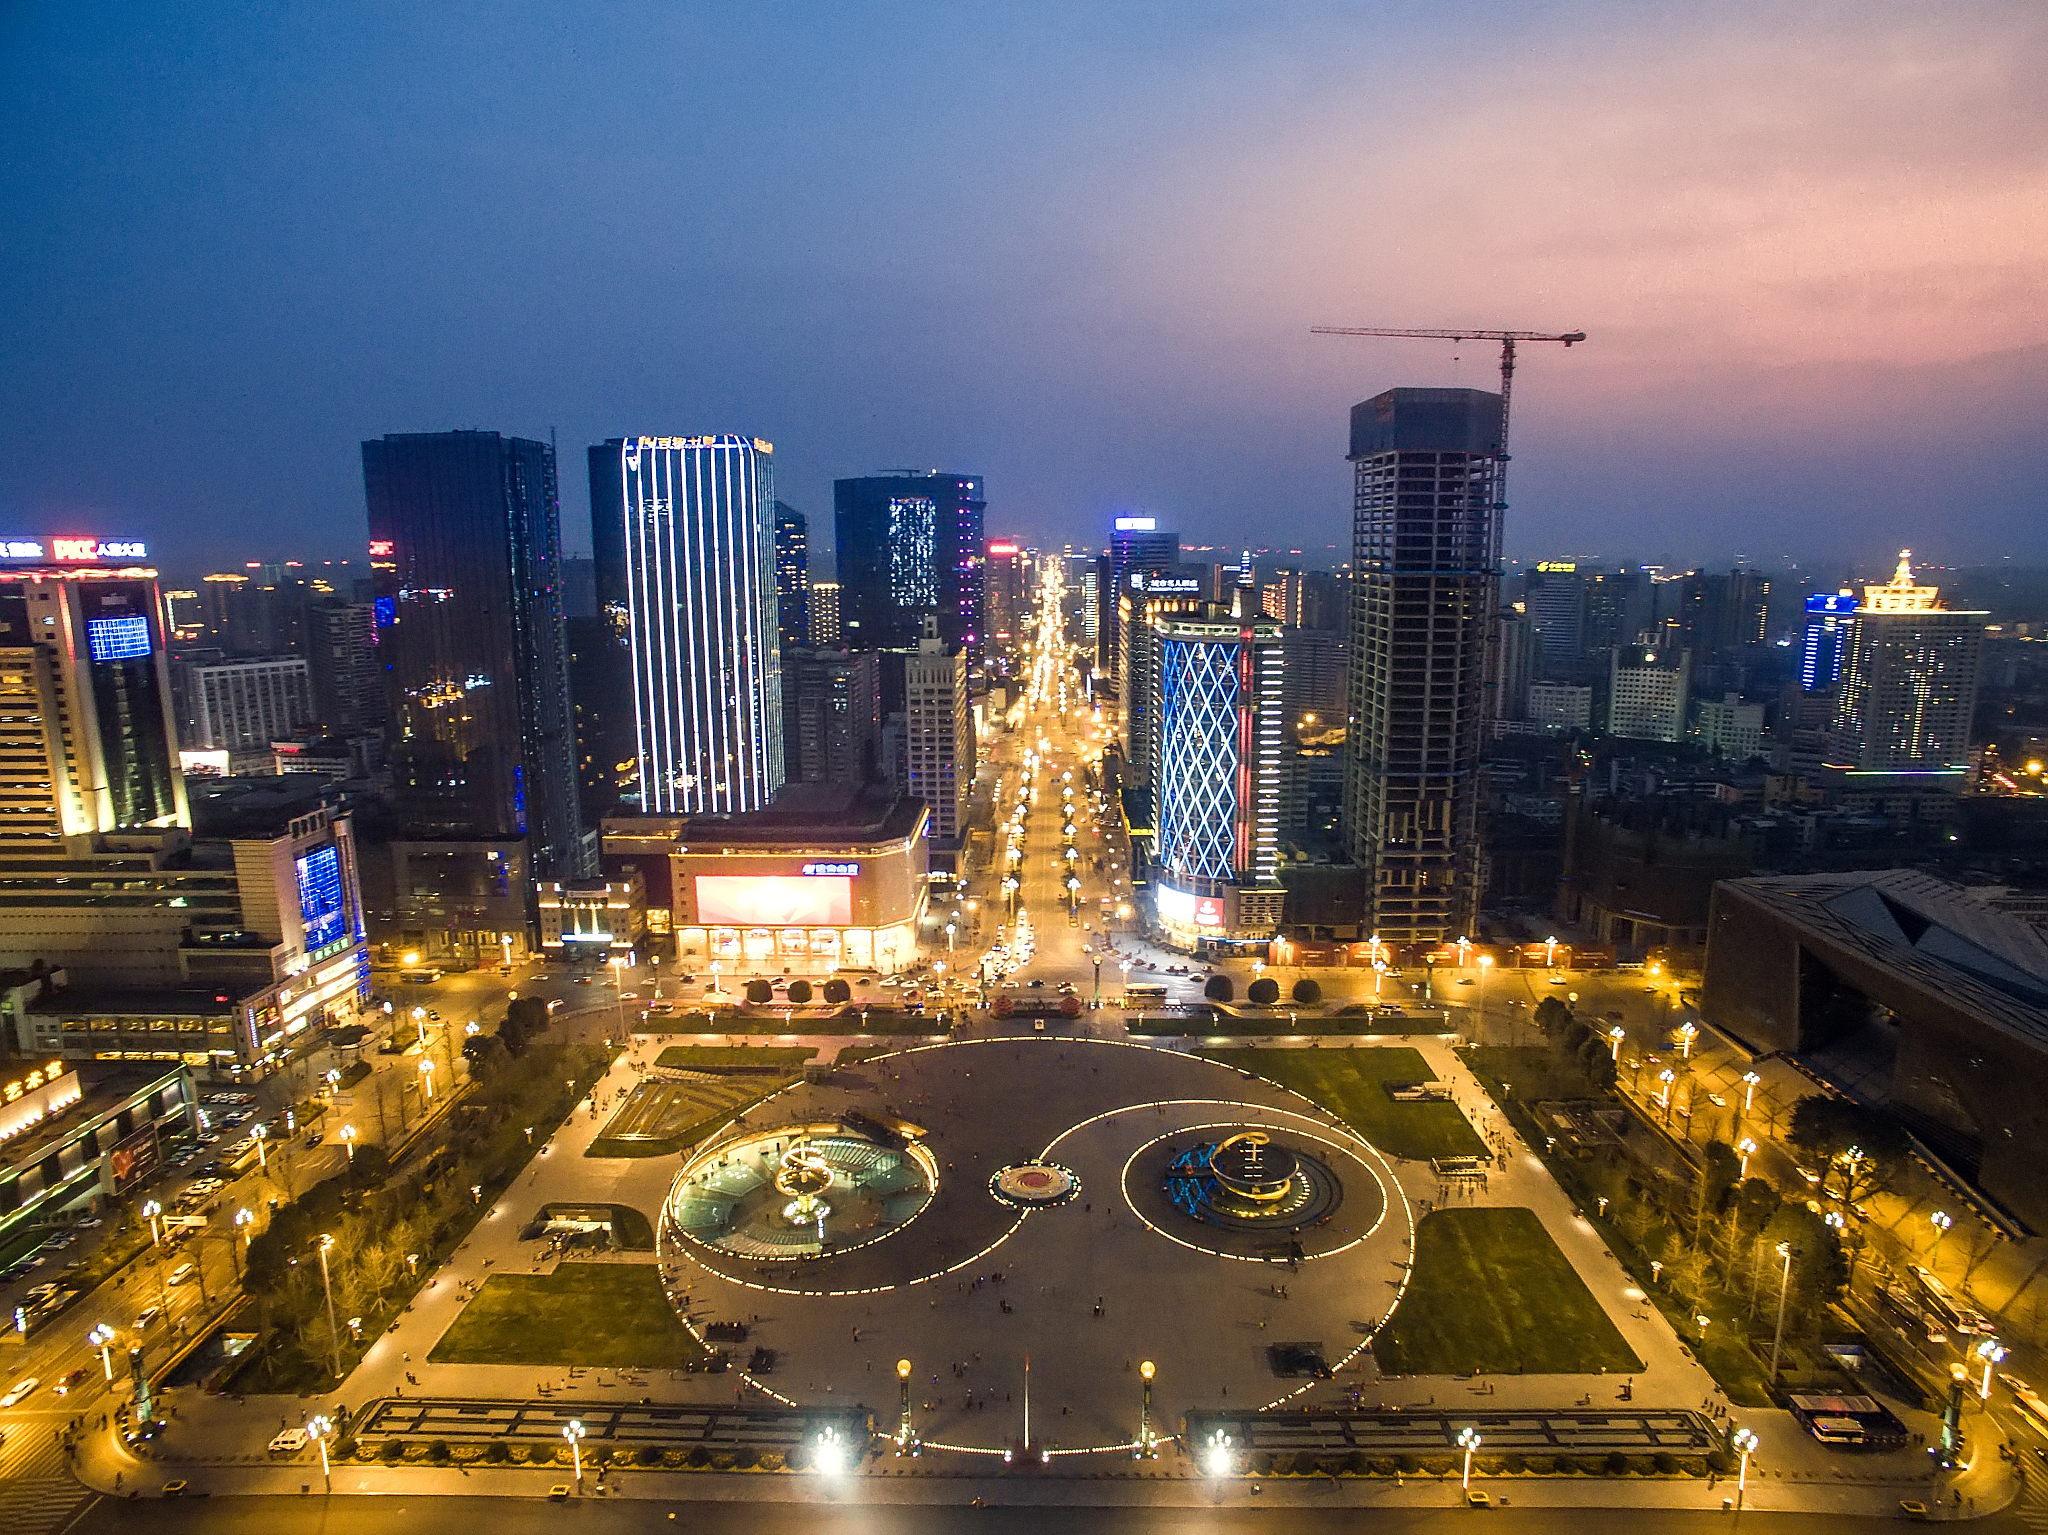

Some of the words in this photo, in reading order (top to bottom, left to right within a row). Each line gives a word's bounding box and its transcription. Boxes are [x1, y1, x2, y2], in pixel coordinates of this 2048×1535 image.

[52, 540, 98, 560] PICC
[3, 1060, 63, 1102] 艺术宫
